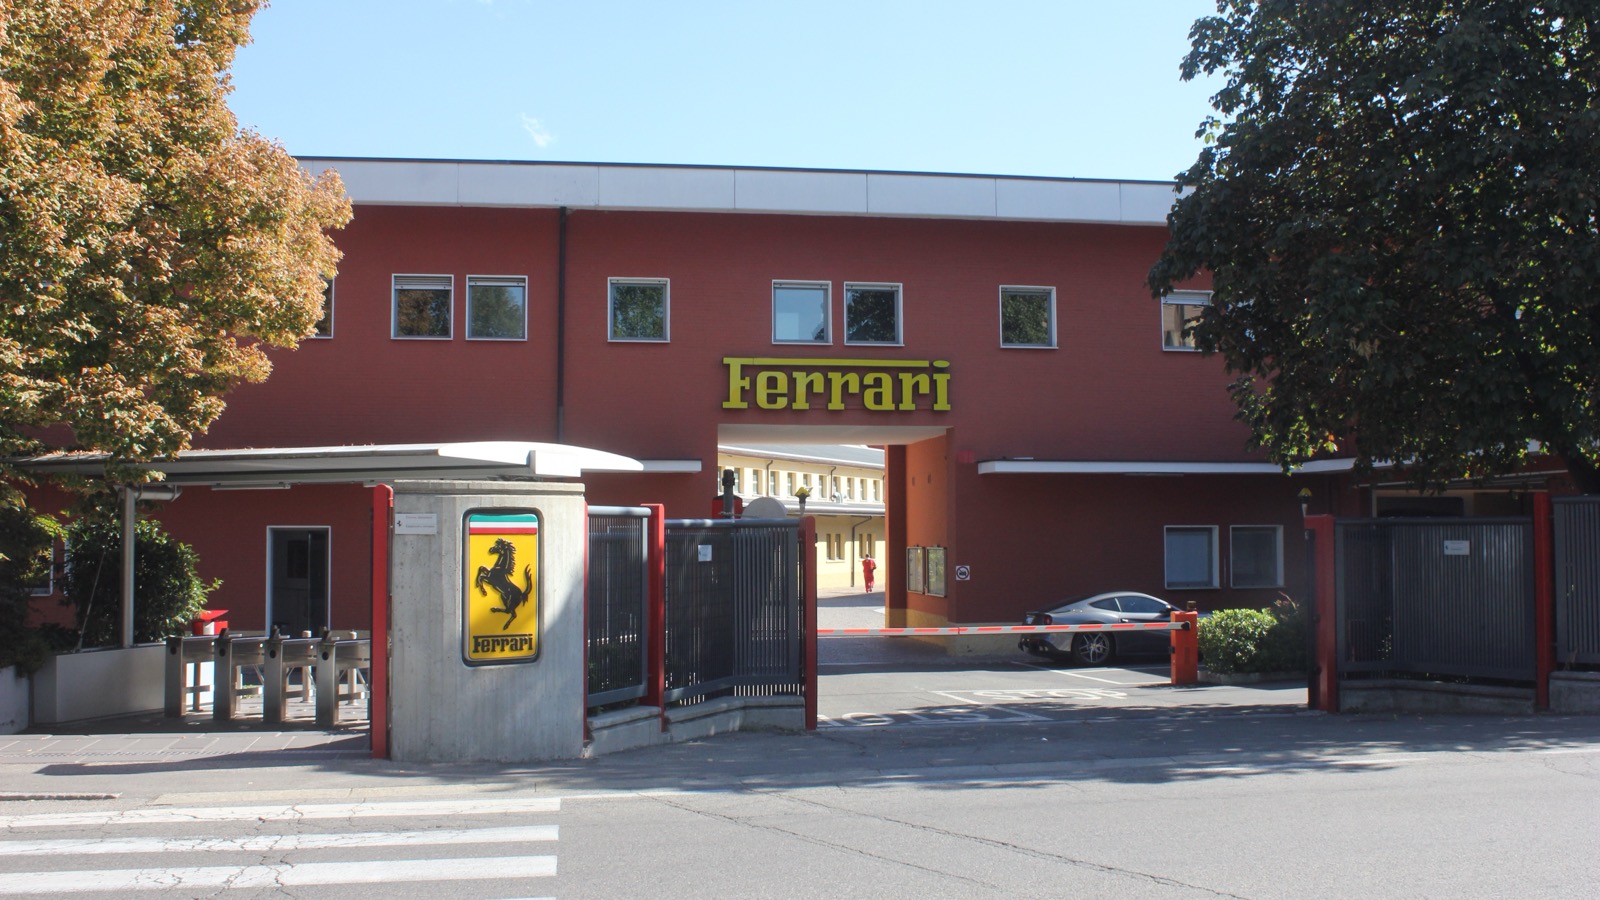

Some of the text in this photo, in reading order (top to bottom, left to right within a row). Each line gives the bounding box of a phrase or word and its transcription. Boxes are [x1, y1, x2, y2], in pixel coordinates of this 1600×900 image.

[722, 357, 951, 411] Ferrari
[472, 633, 533, 653] Ferrari
[973, 689, 1128, 701] STOP
